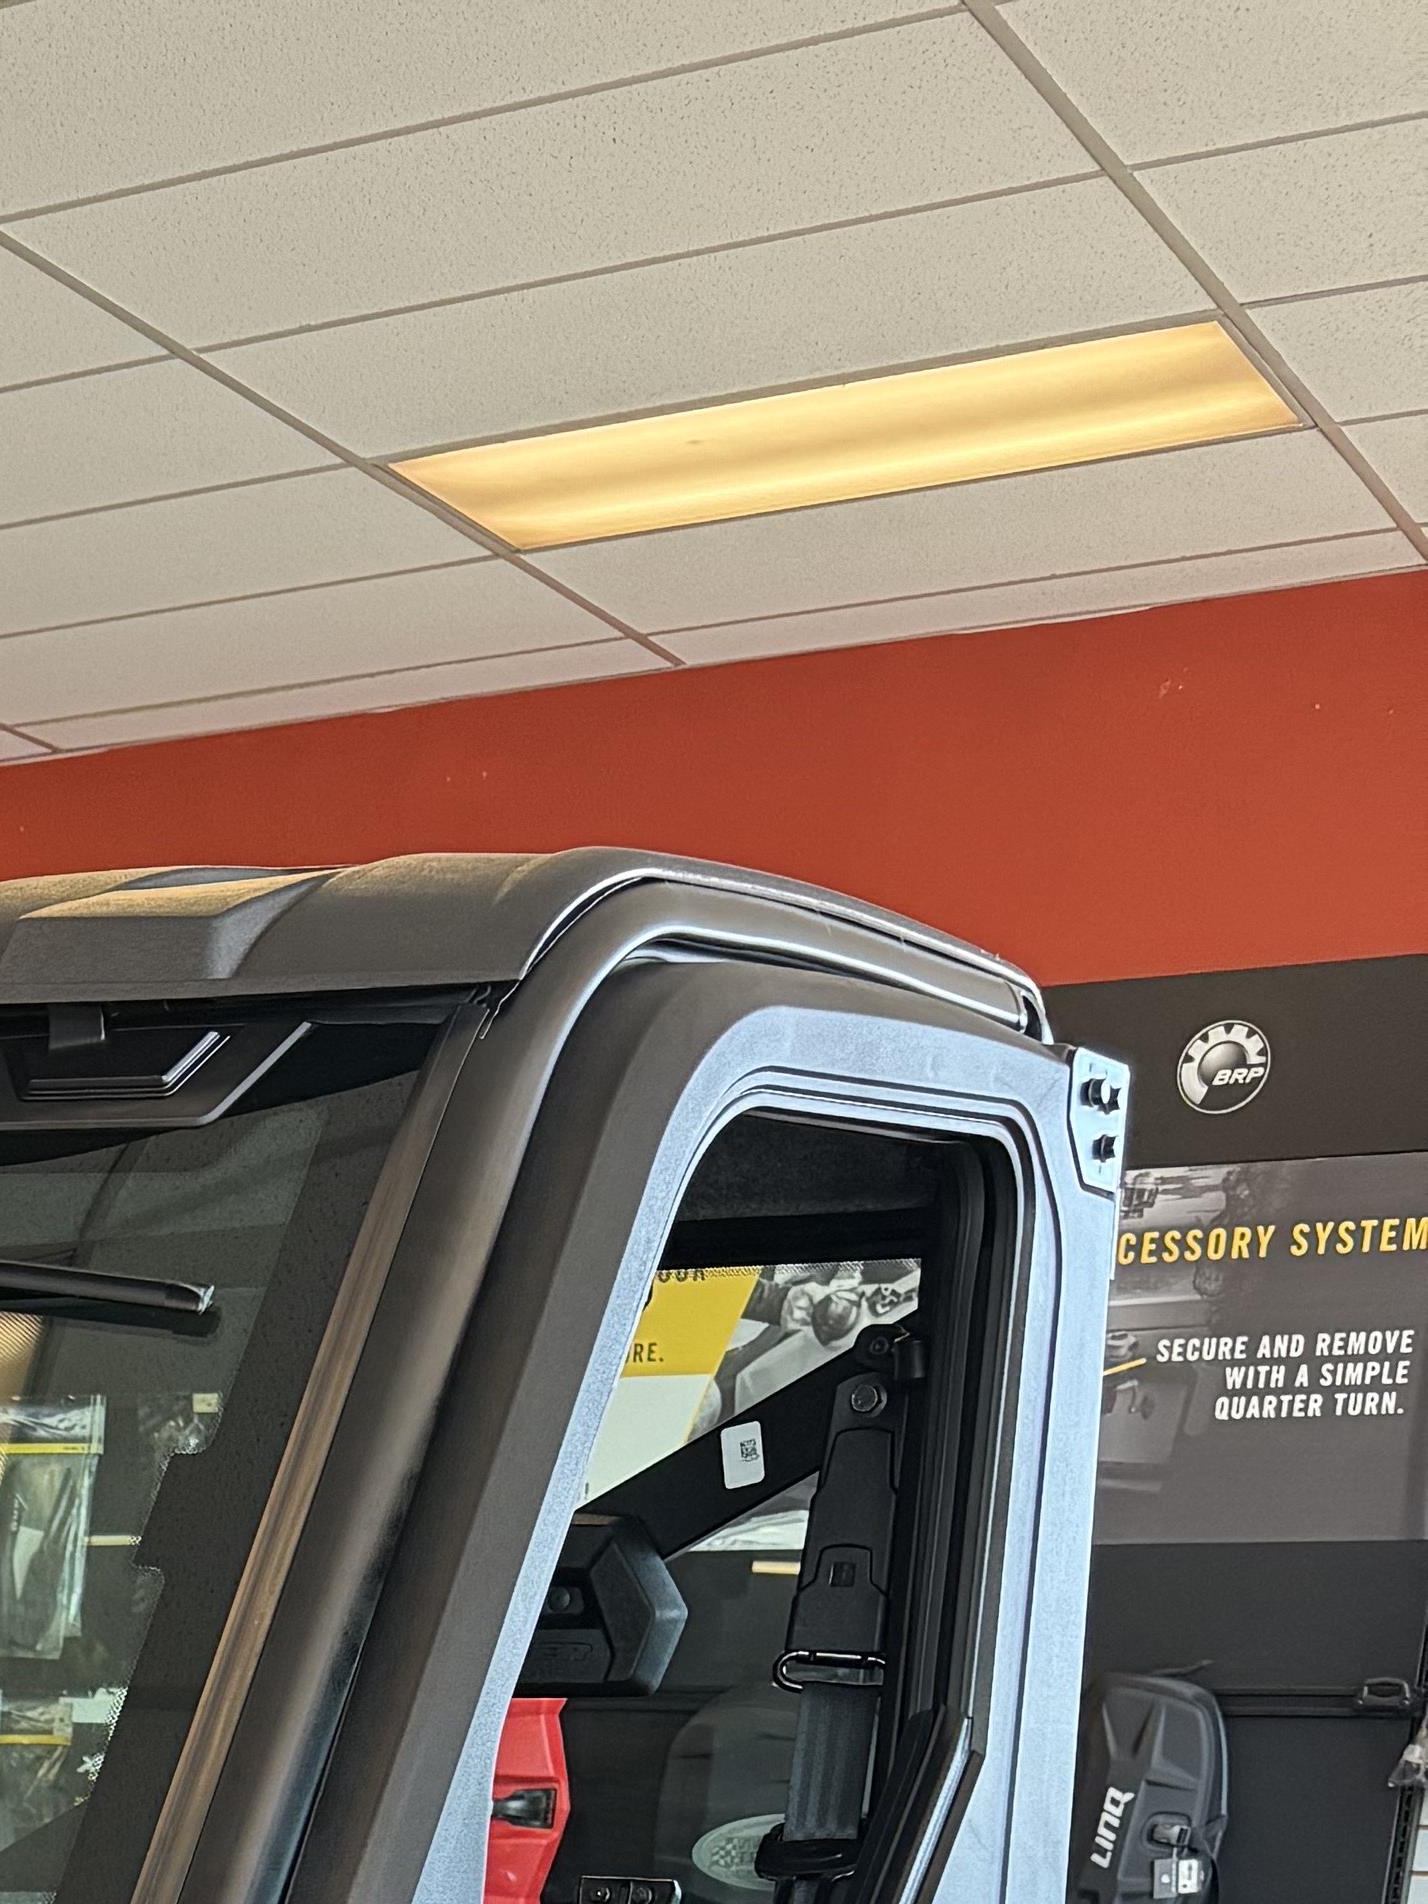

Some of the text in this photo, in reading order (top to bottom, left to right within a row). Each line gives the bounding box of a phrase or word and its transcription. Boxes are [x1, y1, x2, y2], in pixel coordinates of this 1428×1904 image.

[1212, 1067, 1267, 1087] BRP
[1156, 1329, 1415, 1362] SECURE AND REMOVE
[1225, 1361, 1411, 1390] WITH A SIMPLE
[1214, 1391, 1405, 1420] QUARTER TURN.
